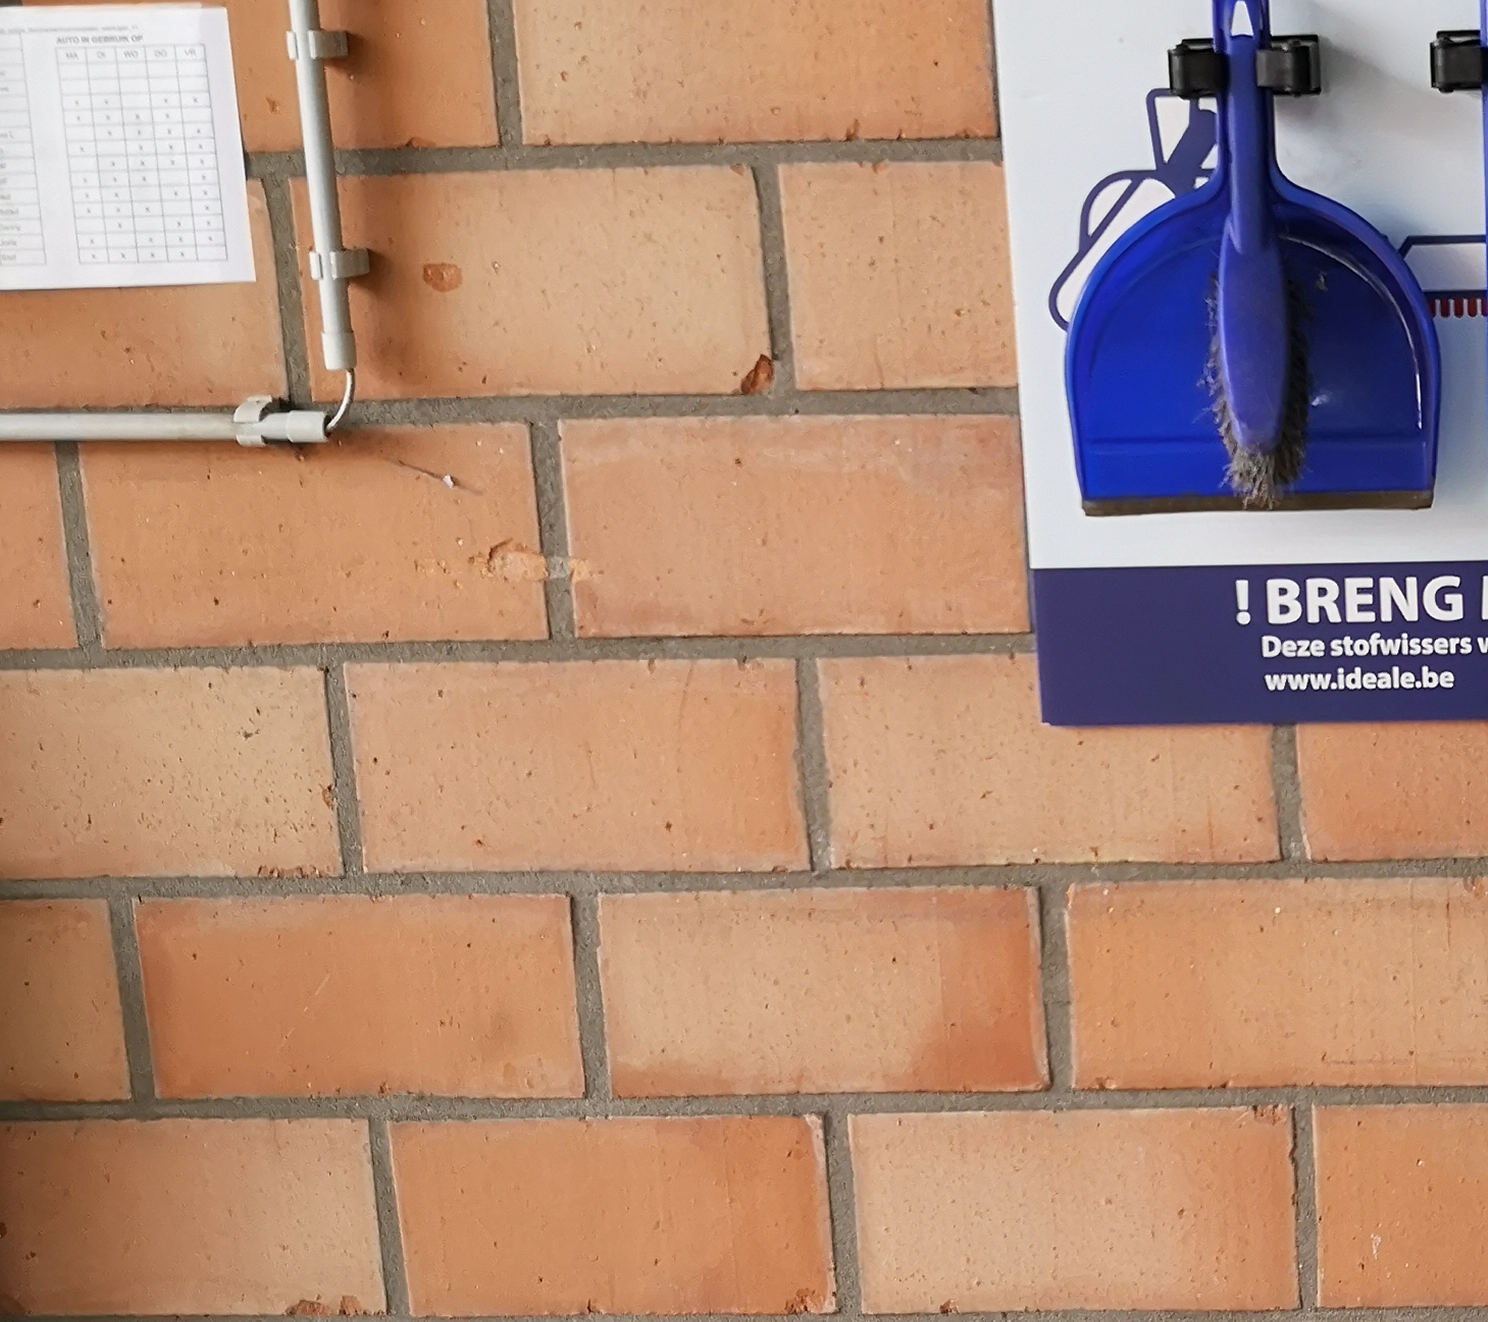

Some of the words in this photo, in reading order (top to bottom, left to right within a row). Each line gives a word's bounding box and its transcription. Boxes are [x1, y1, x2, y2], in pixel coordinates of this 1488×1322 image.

[1266, 575, 1464, 625] BRENG
[1261, 635, 1326, 658] Deze
[1330, 632, 1473, 657] stofwissers
[1264, 664, 1455, 691] www.ideale.be
